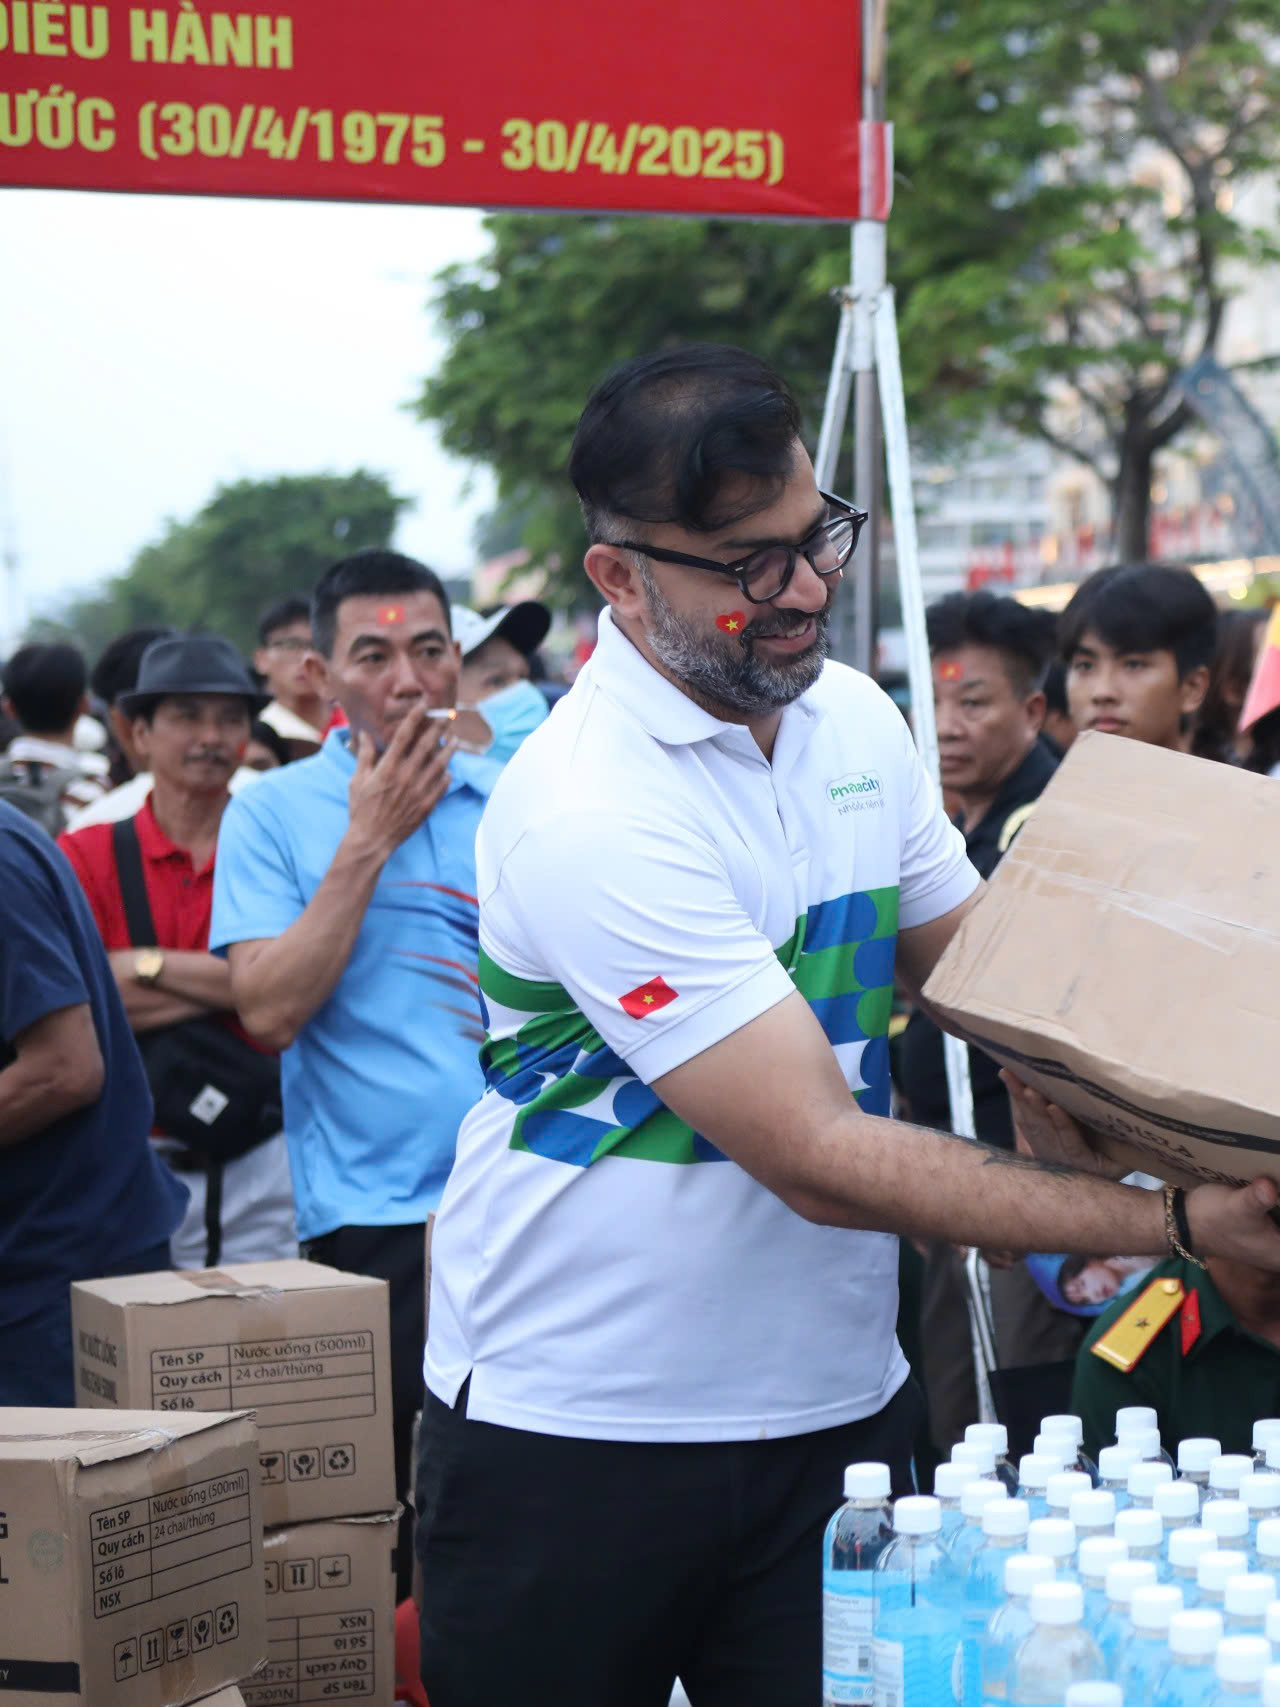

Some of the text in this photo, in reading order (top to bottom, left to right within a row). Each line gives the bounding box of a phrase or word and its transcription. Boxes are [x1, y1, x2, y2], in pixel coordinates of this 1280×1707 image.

[129, 1, 293, 69] HÀNH
[139, 100, 446, 168] (30/4/1975
[462, 139, 485, 153] -
[502, 118, 784, 186] 30/4/2025)
[233, 1335, 366, 1360] Nước uống (500ml)
[159, 1351, 205, 1368] Tên SP
[159, 1370, 223, 1388] Quy cách
[235, 1361, 324, 1381] 24 chai/thùng
[160, 1396, 178, 1411] Số
[152, 1476, 245, 1515] Nước uống (500ml)
[97, 1510, 131, 1532] Tên SP
[154, 1510, 216, 1540] 24 chai/thùng
[97, 1530, 145, 1556] Quy cách
[99, 1565, 125, 1585] Số lô
[99, 1591, 121, 1611] NSX
[339, 1615, 367, 1629] NSX
